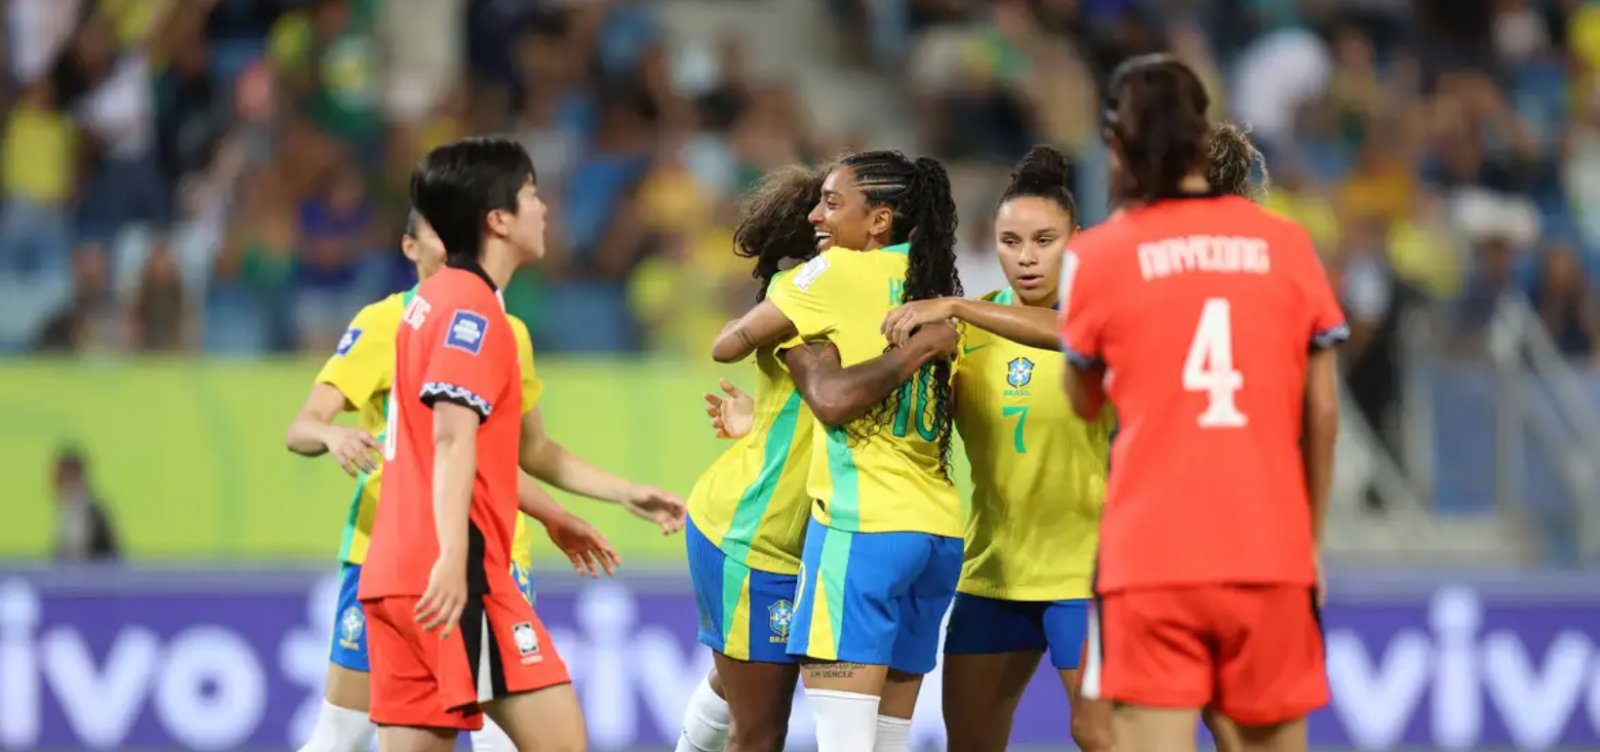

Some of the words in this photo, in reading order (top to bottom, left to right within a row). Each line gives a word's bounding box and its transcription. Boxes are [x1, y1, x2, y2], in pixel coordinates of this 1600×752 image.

[1182, 298, 1248, 427] 4
[1002, 405, 1029, 453] 7
[769, 636, 788, 644] BRA
[1326, 584, 1600, 752] viv
